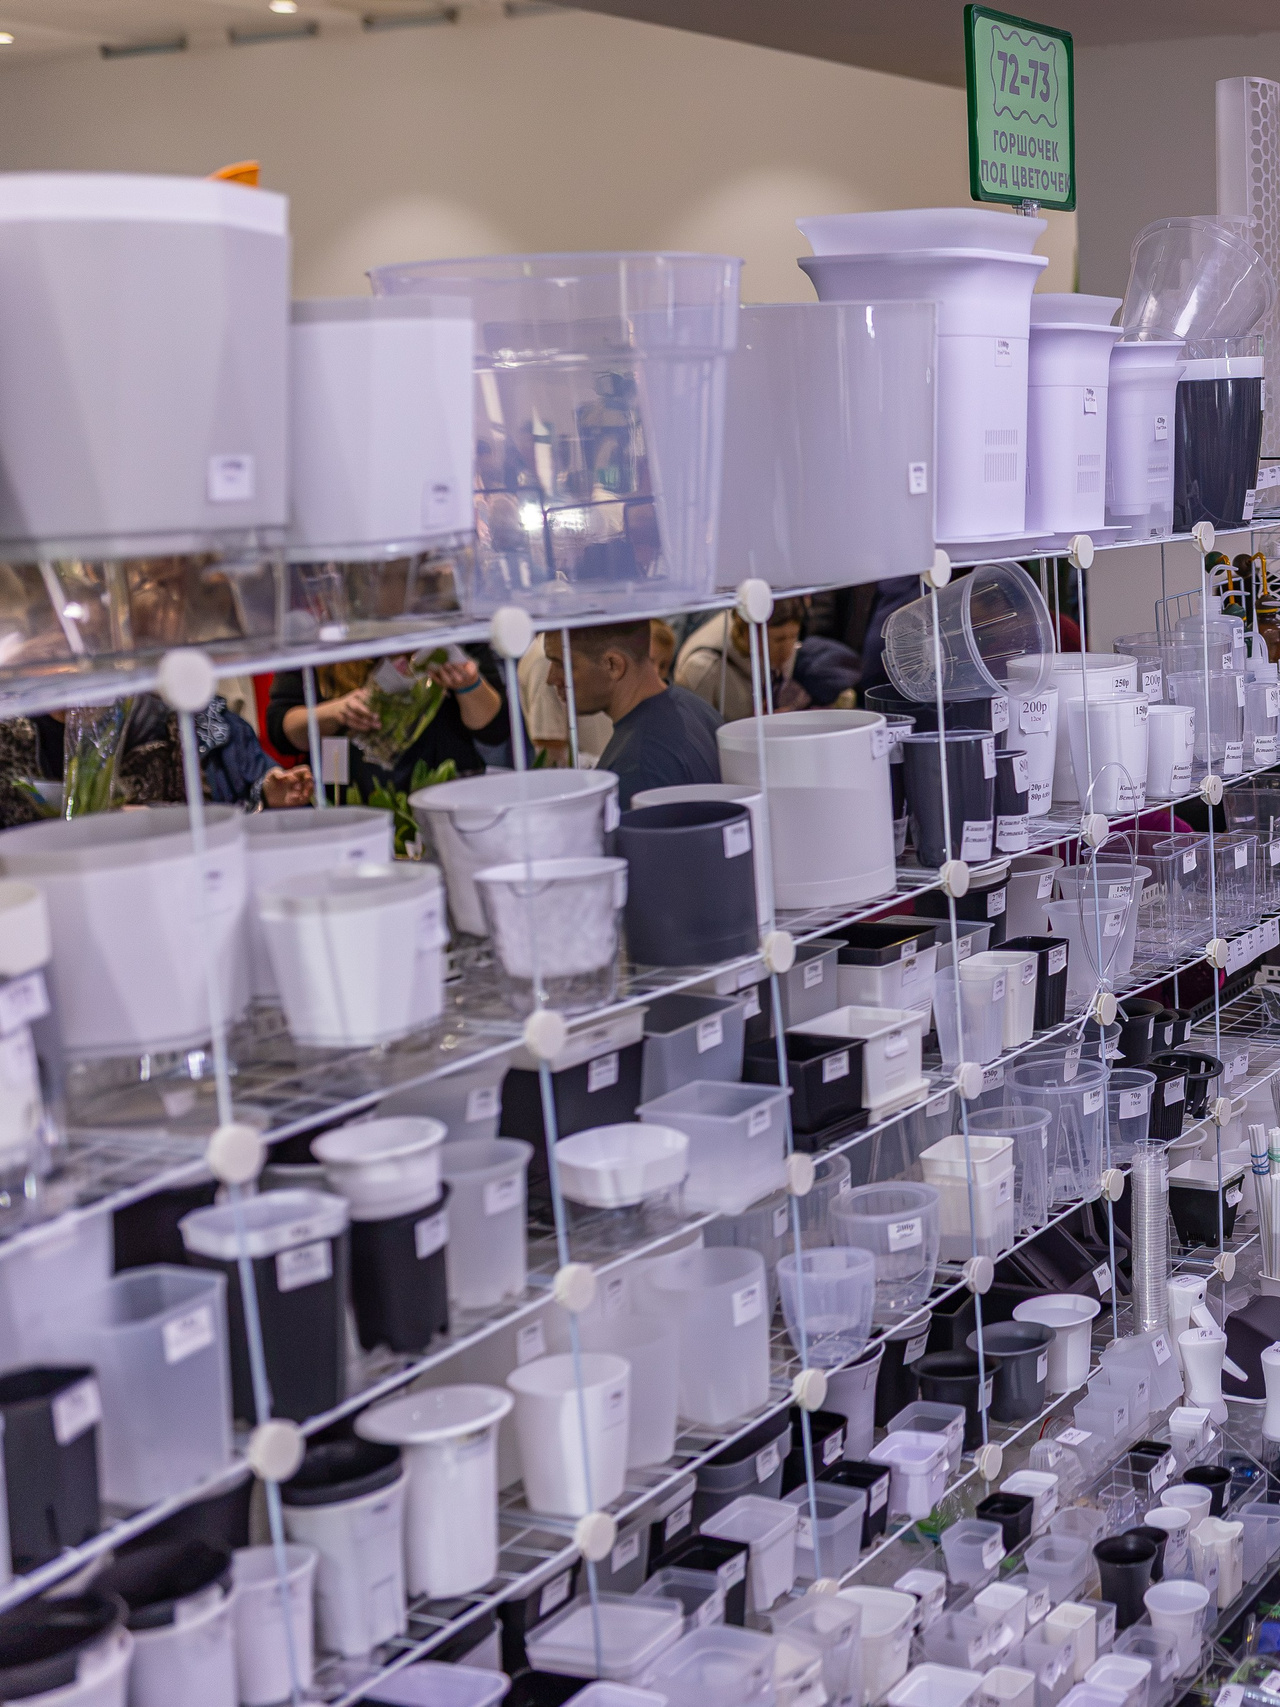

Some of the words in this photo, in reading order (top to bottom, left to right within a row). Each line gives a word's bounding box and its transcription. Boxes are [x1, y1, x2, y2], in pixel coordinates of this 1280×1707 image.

[997, 50, 1050, 103] 72-73
[993, 129, 1059, 163] ГОРШОЧЕК
[980, 159, 1008, 188] ПОД
[1114, 678, 1130, 688] 250р
[1145, 674, 1161, 687] 200р
[1022, 700, 1048, 715] 200р
[1130, 1092, 1142, 1100] 70р
